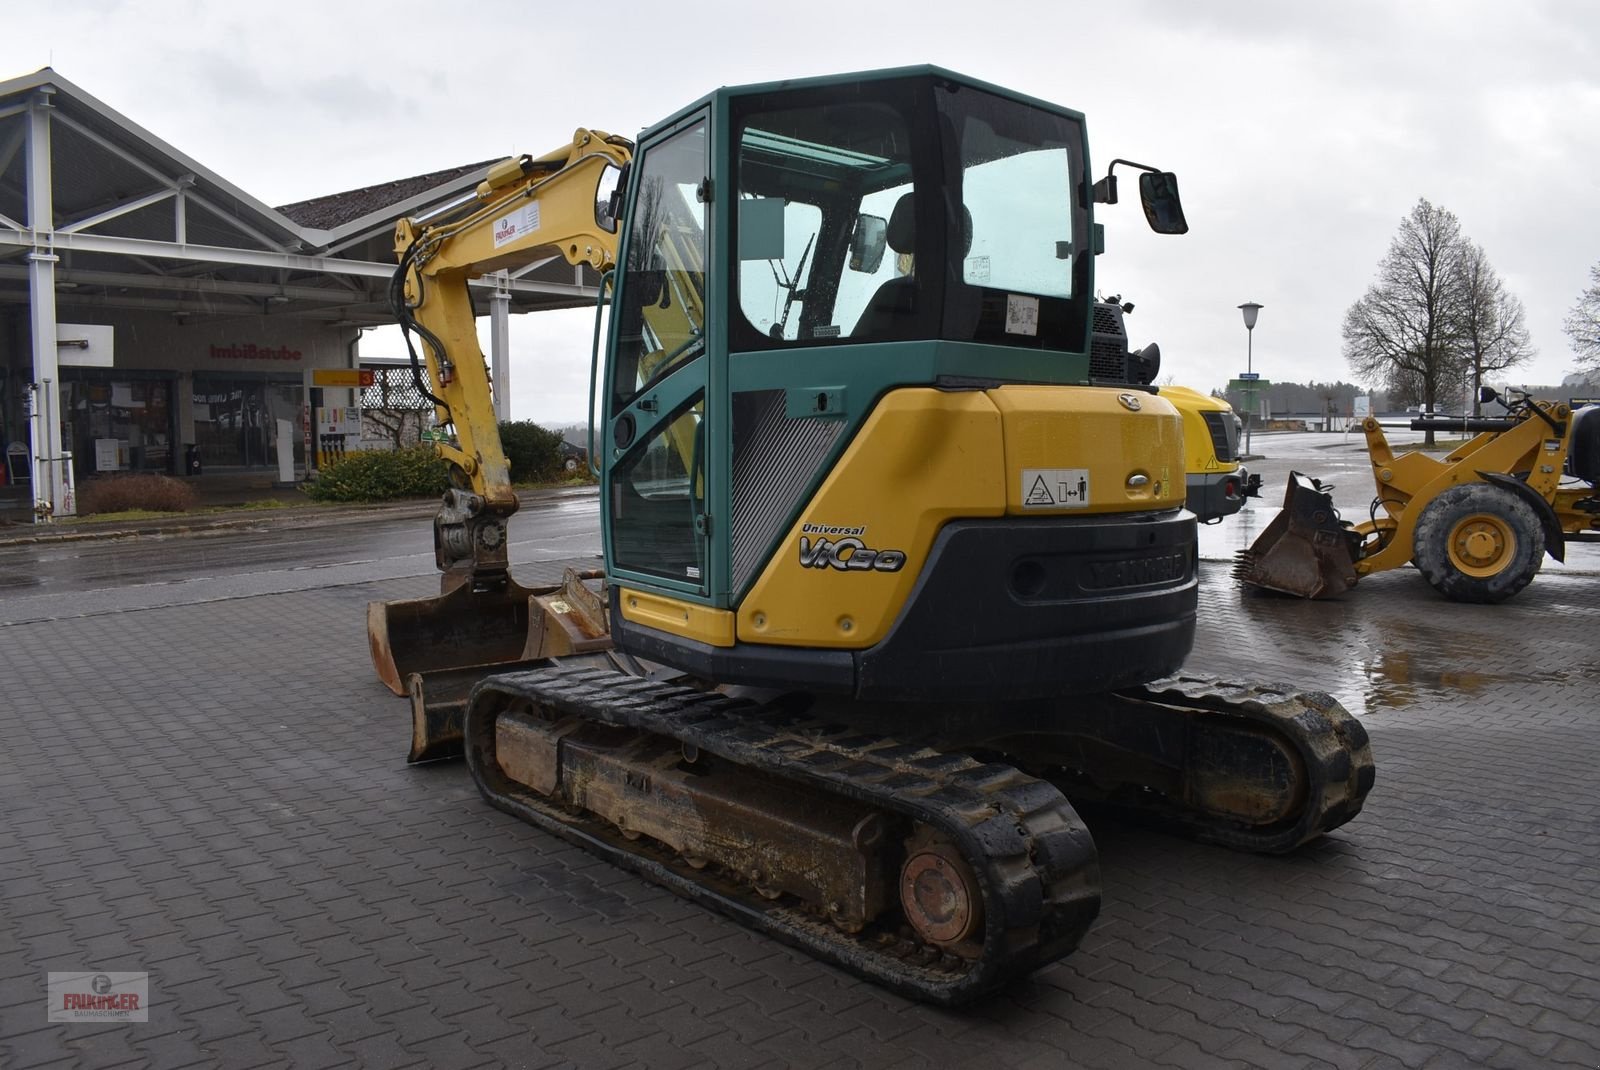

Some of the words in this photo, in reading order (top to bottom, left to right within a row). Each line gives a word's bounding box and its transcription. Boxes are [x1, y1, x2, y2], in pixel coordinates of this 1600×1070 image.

[209, 343, 302, 361] Imbißstube
[362, 373, 371, 385] 3
[802, 523, 865, 535] Universal
